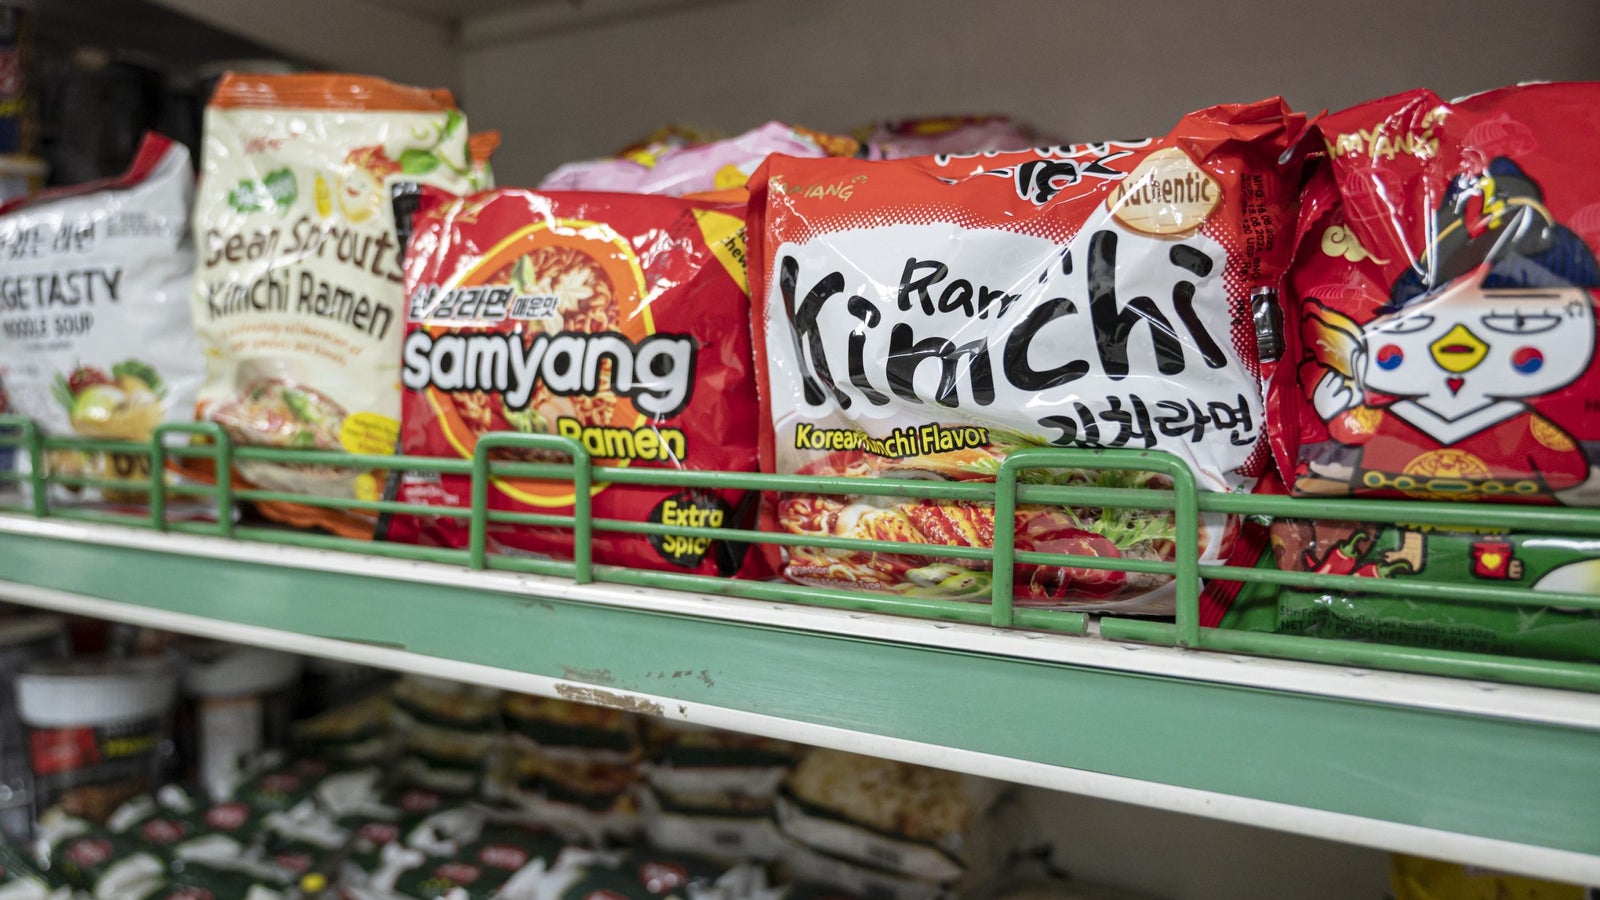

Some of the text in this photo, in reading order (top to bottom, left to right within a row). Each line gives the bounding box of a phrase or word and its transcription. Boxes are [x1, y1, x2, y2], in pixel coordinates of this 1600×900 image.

[1117, 172, 1211, 209] Authentic
[208, 268, 289, 319] Kimchi
[299, 271, 394, 340] Ramen
[512, 297, 558, 318] 매운맛
[778, 229, 1227, 410] Kimchi
[55, 313, 94, 335] SOUP
[403, 331, 696, 416] samyang
[558, 418, 686, 461] Ramen
[921, 423, 989, 452] Flavor
[1037, 393, 1257, 449] 김치라면
[662, 500, 724, 528] Extra
[662, 534, 712, 558] Spic
